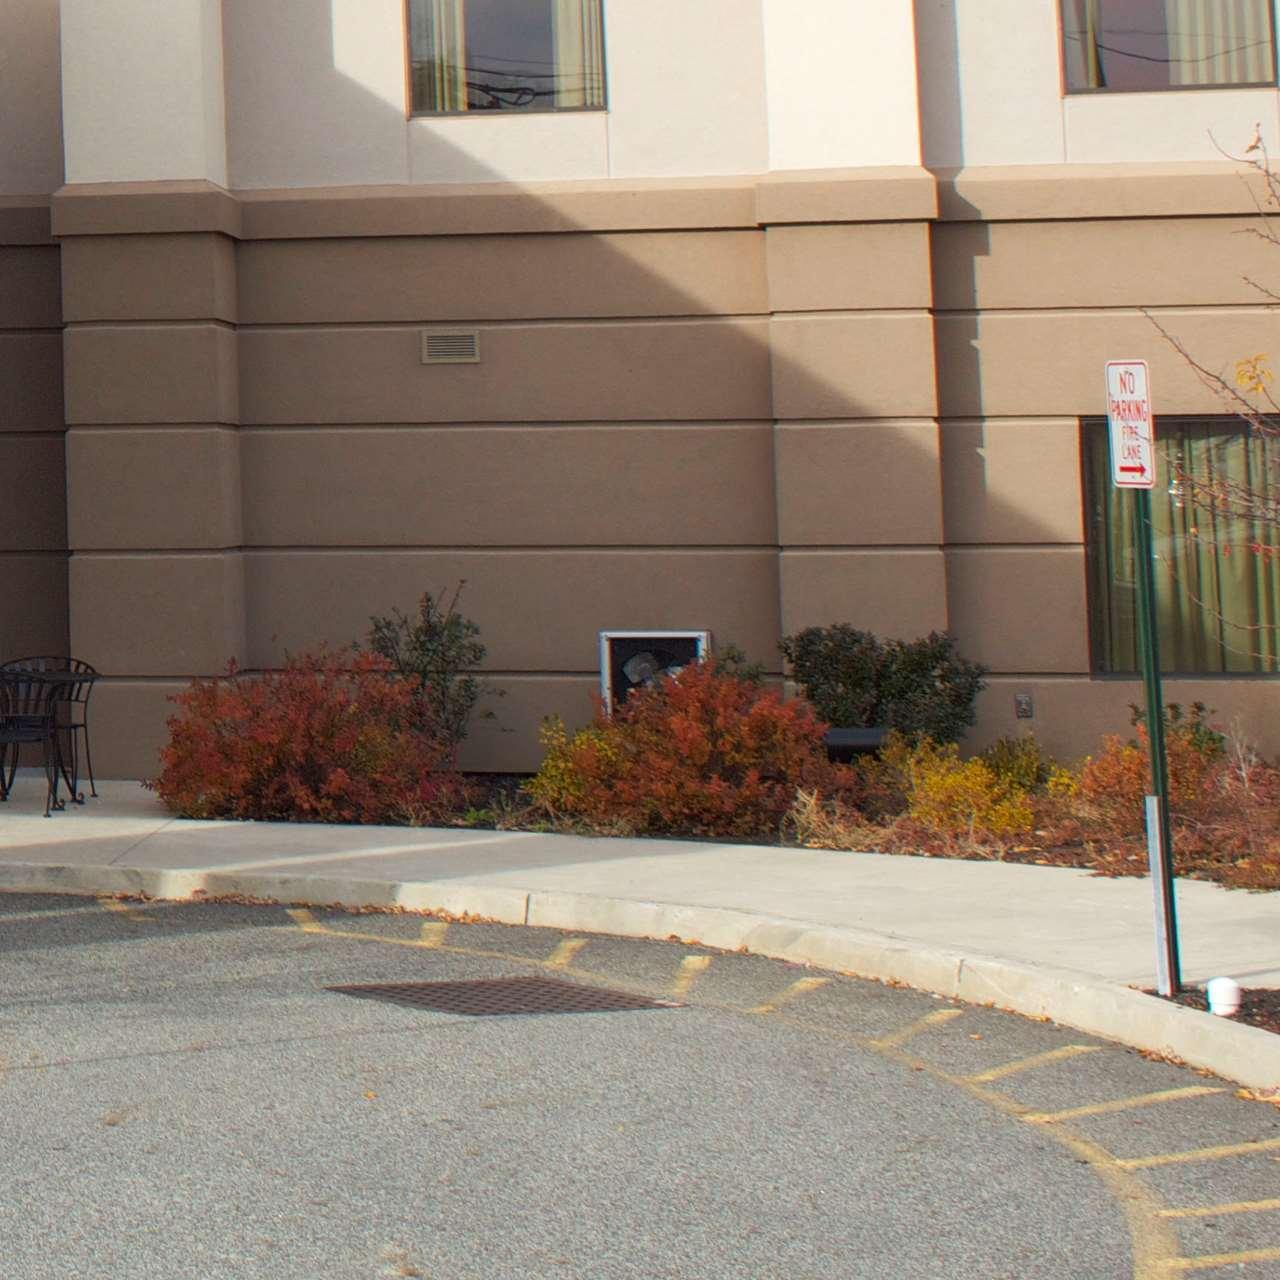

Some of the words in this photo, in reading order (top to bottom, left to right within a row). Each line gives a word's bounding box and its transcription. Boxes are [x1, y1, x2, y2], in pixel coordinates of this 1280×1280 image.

[1118, 371, 1136, 395] NO
[1111, 399, 1148, 422] PARKING
[1121, 425, 1140, 441] FIRE
[1121, 444, 1143, 460] LANE
